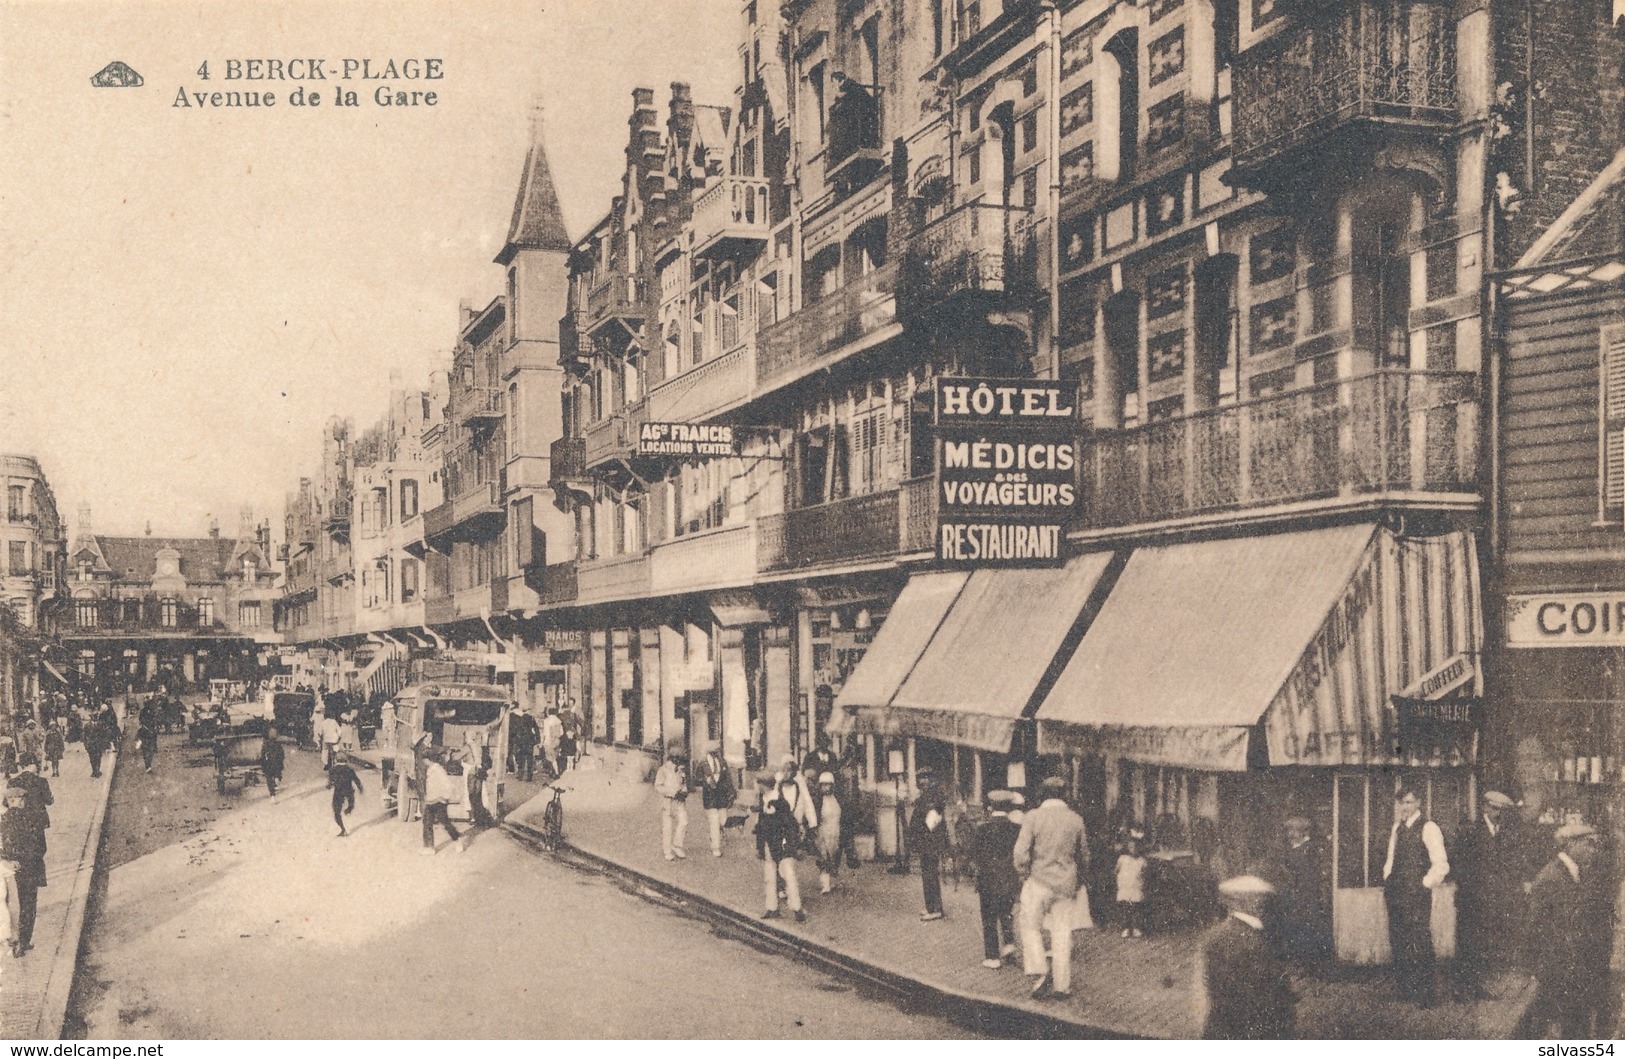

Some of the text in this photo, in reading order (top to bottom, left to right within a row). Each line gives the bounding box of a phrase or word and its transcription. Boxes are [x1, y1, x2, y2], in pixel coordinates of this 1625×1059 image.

[942, 382, 1073, 417] HÔTEL
[671, 425, 732, 443] FRANCIS
[641, 441, 732, 455] LOCATIONS VENTES
[944, 438, 1074, 470] MÉDICIS
[943, 481, 1075, 506] VOYAGEURS
[942, 523, 1061, 560] RESTAURANT
[545, 631, 583, 642] PIANOS
